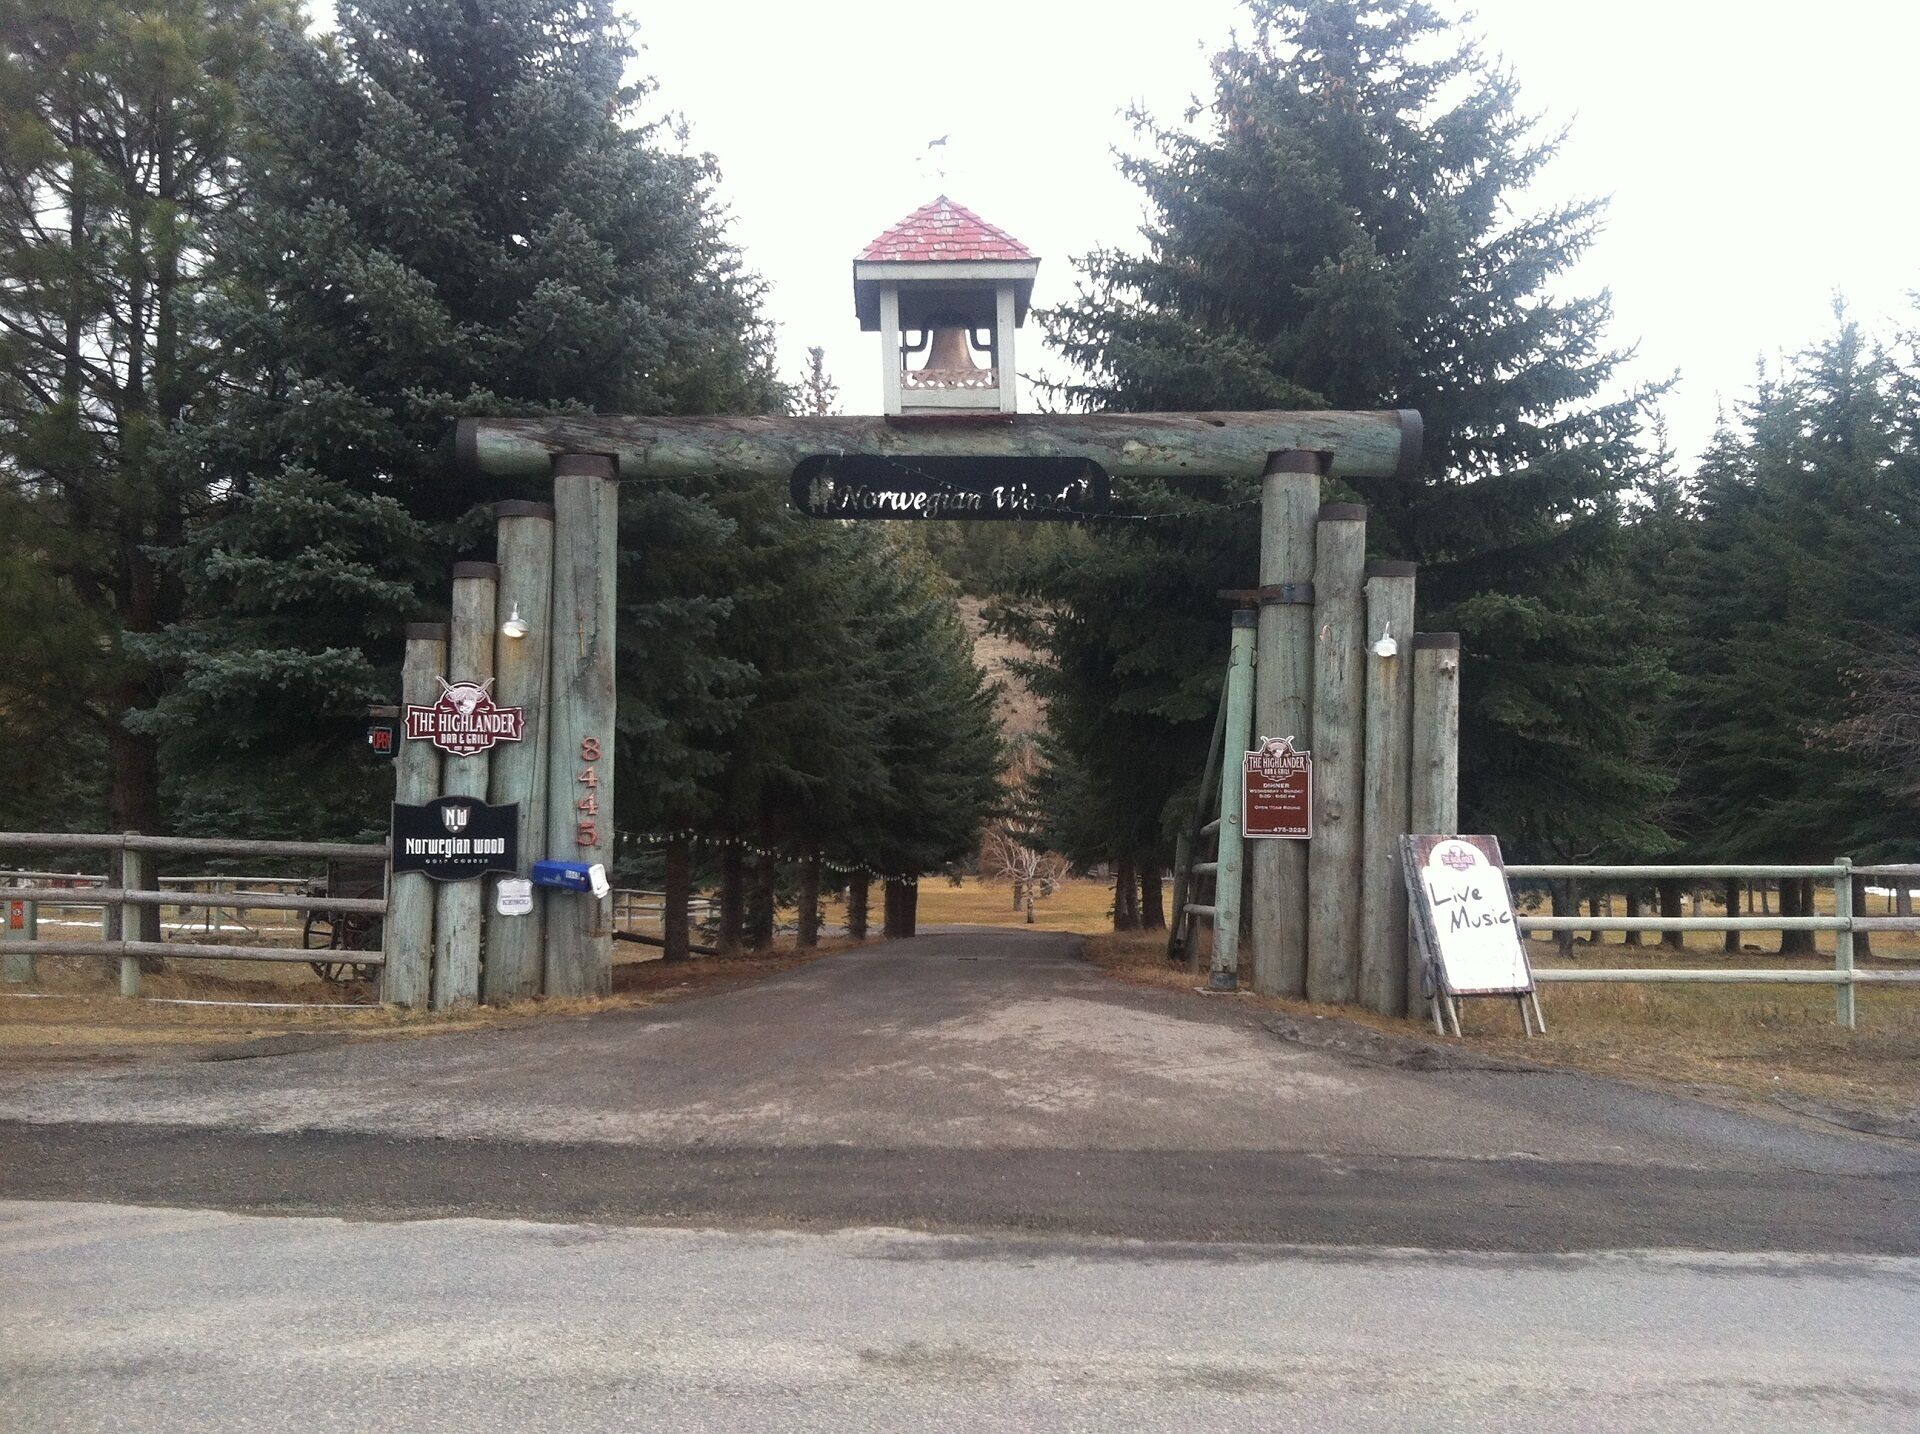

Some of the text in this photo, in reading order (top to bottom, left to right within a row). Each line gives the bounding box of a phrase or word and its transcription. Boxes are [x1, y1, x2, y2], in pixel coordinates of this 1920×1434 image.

[411, 711, 517, 737] THE HIGHLANDER
[440, 733, 458, 744] BAR
[466, 734, 489, 745] GRILL
[1249, 757, 1305, 771] THE HIGHLANDER
[405, 837, 471, 858] Norwegian
[1429, 882, 1483, 907] Live
[1450, 906, 1511, 932] Music
